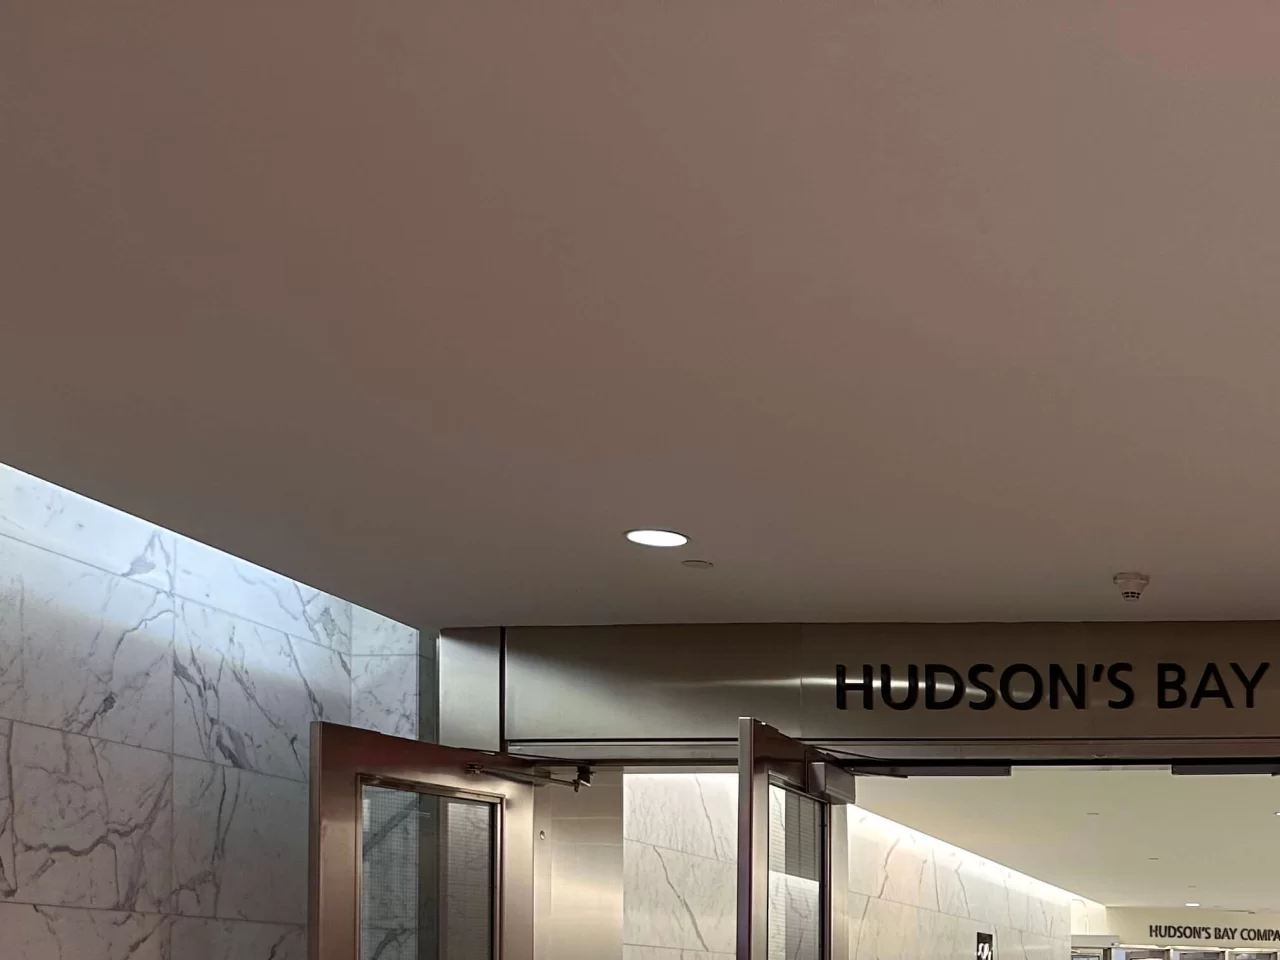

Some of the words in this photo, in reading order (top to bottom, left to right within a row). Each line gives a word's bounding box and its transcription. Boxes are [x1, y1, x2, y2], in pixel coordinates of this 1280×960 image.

[835, 662, 1136, 711] HUDSON'S
[1156, 661, 1270, 709] BAY
[1149, 924, 1212, 940] HUDSON'S
[1214, 926, 1238, 940] BAY
